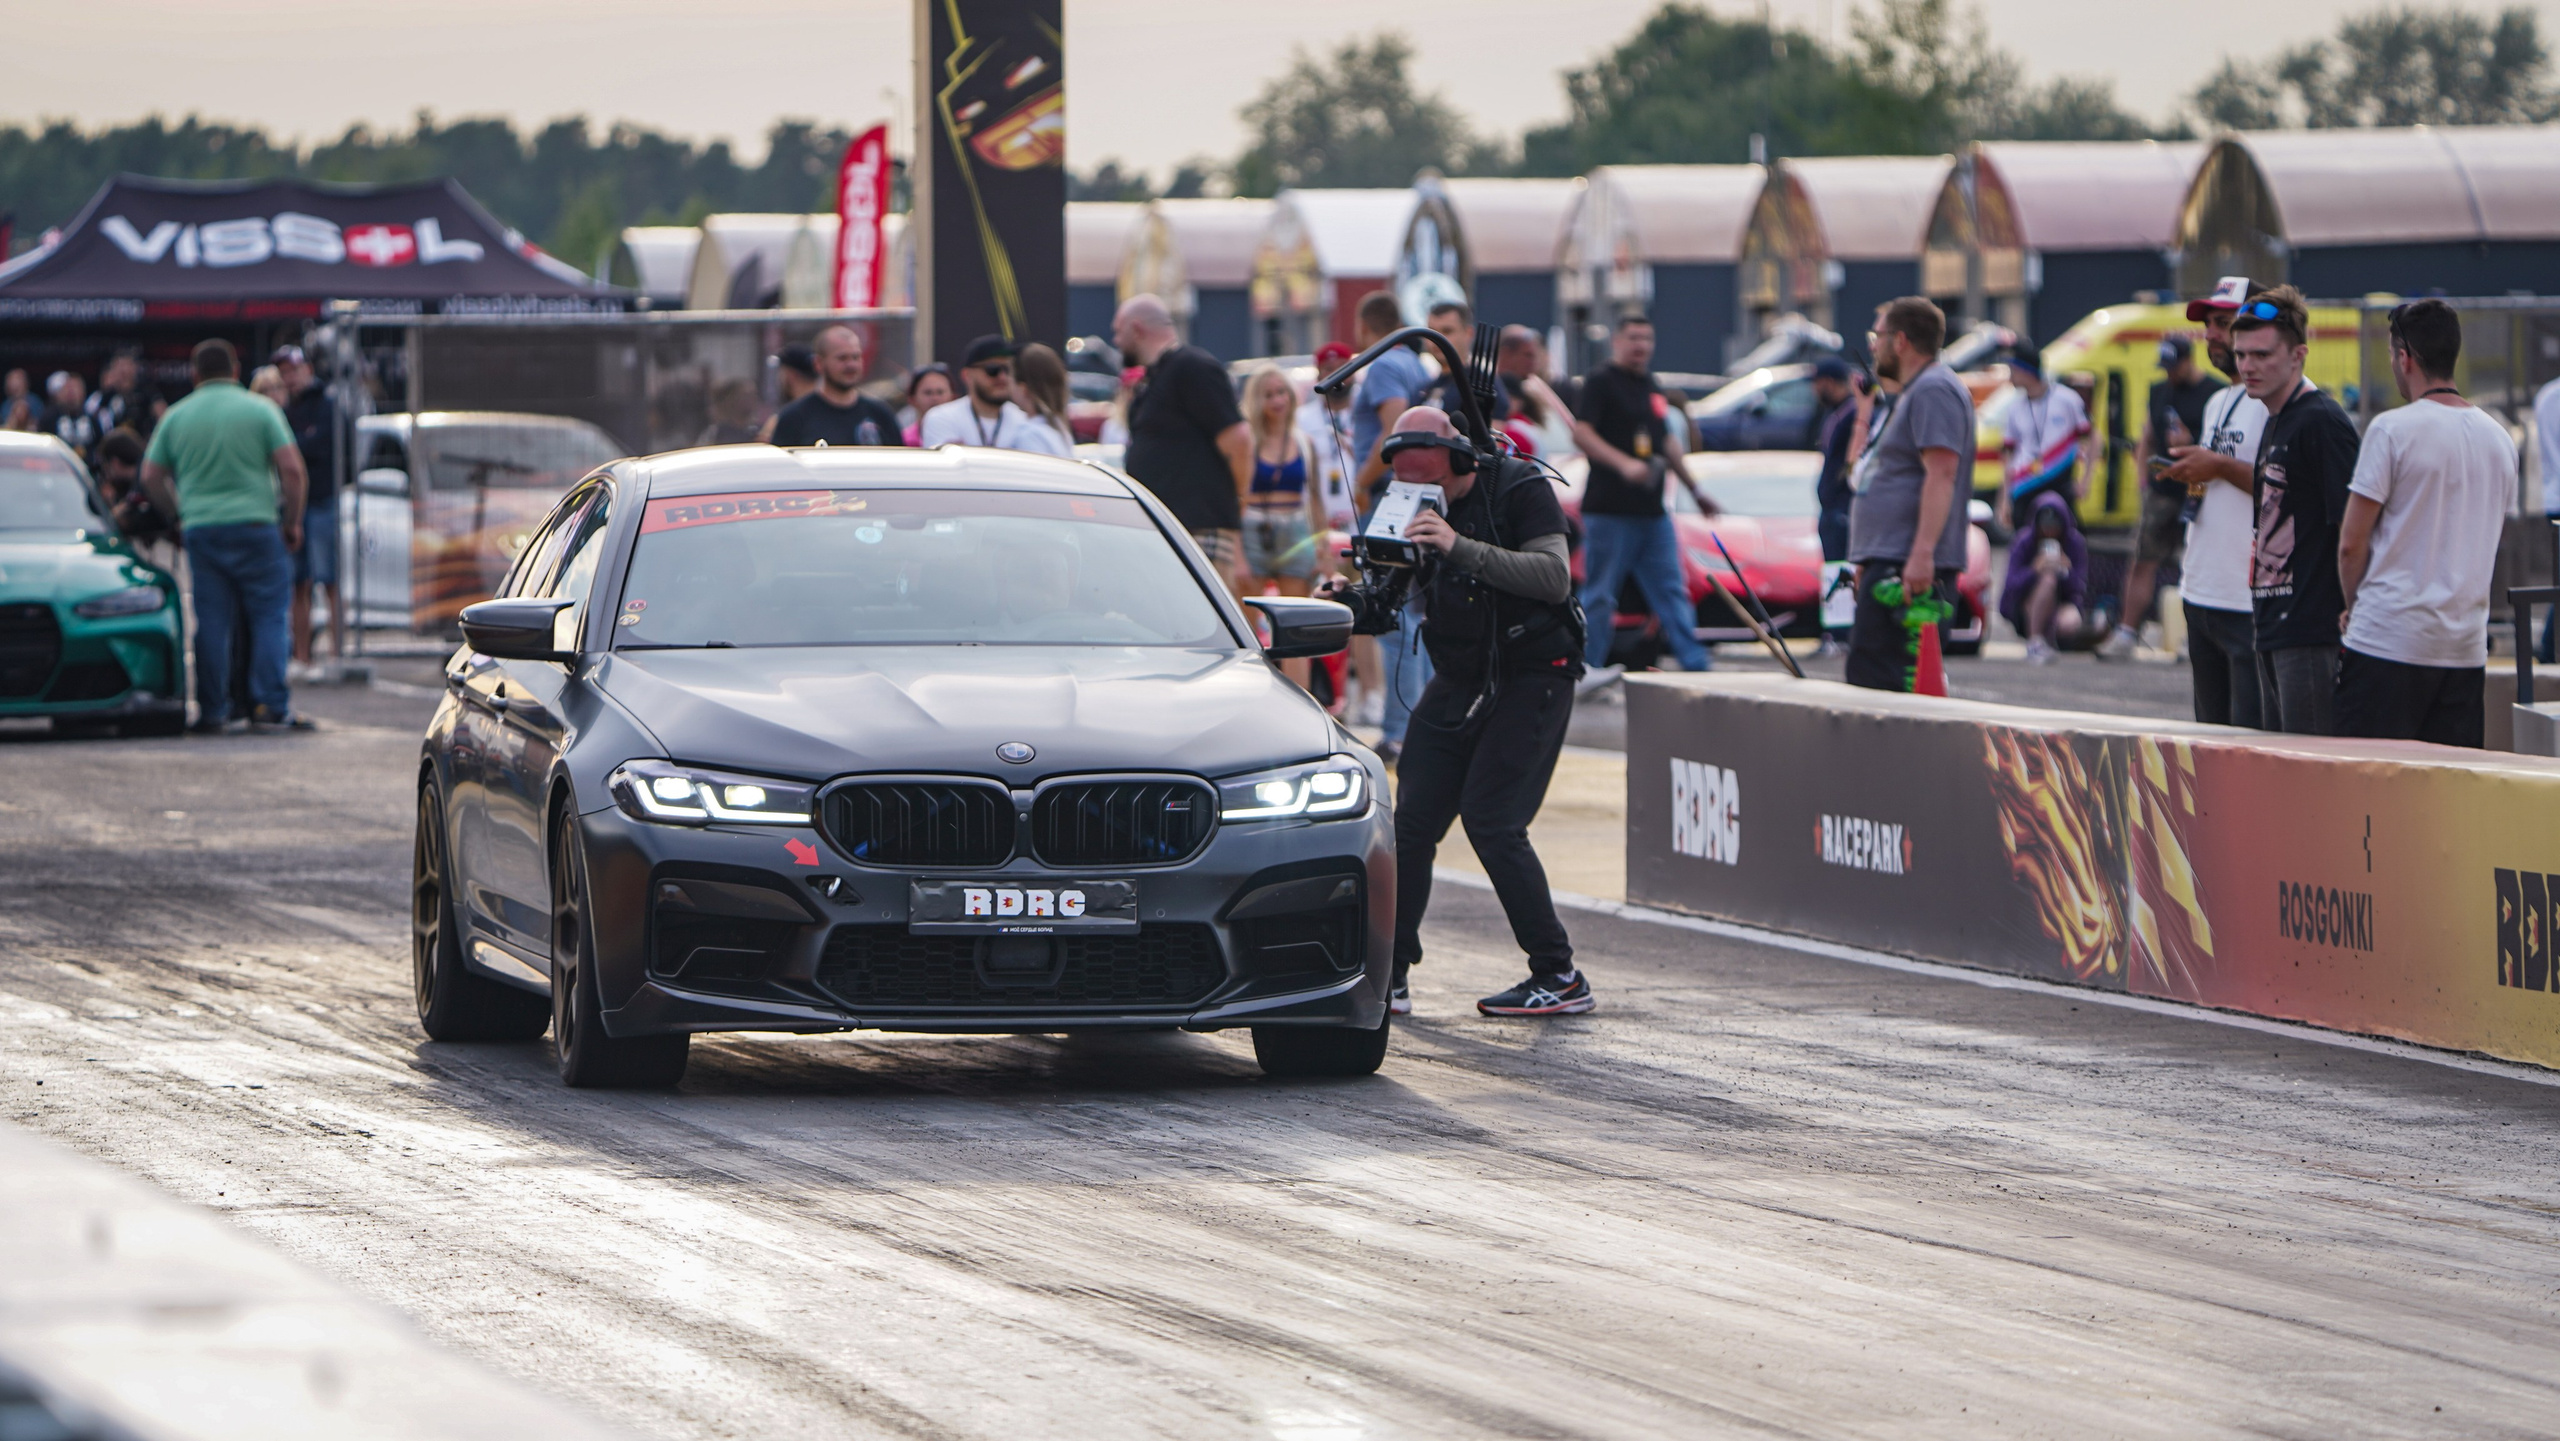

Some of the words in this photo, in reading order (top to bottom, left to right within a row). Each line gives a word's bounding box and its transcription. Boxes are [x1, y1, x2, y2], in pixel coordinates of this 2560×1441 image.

[664, 496, 811, 524] RDRC
[1670, 756, 1740, 866] RDRC
[1821, 813, 1904, 875] RACEPARK
[963, 888, 1086, 917] RDRC
[2279, 880, 2373, 952] ROSGONKI
